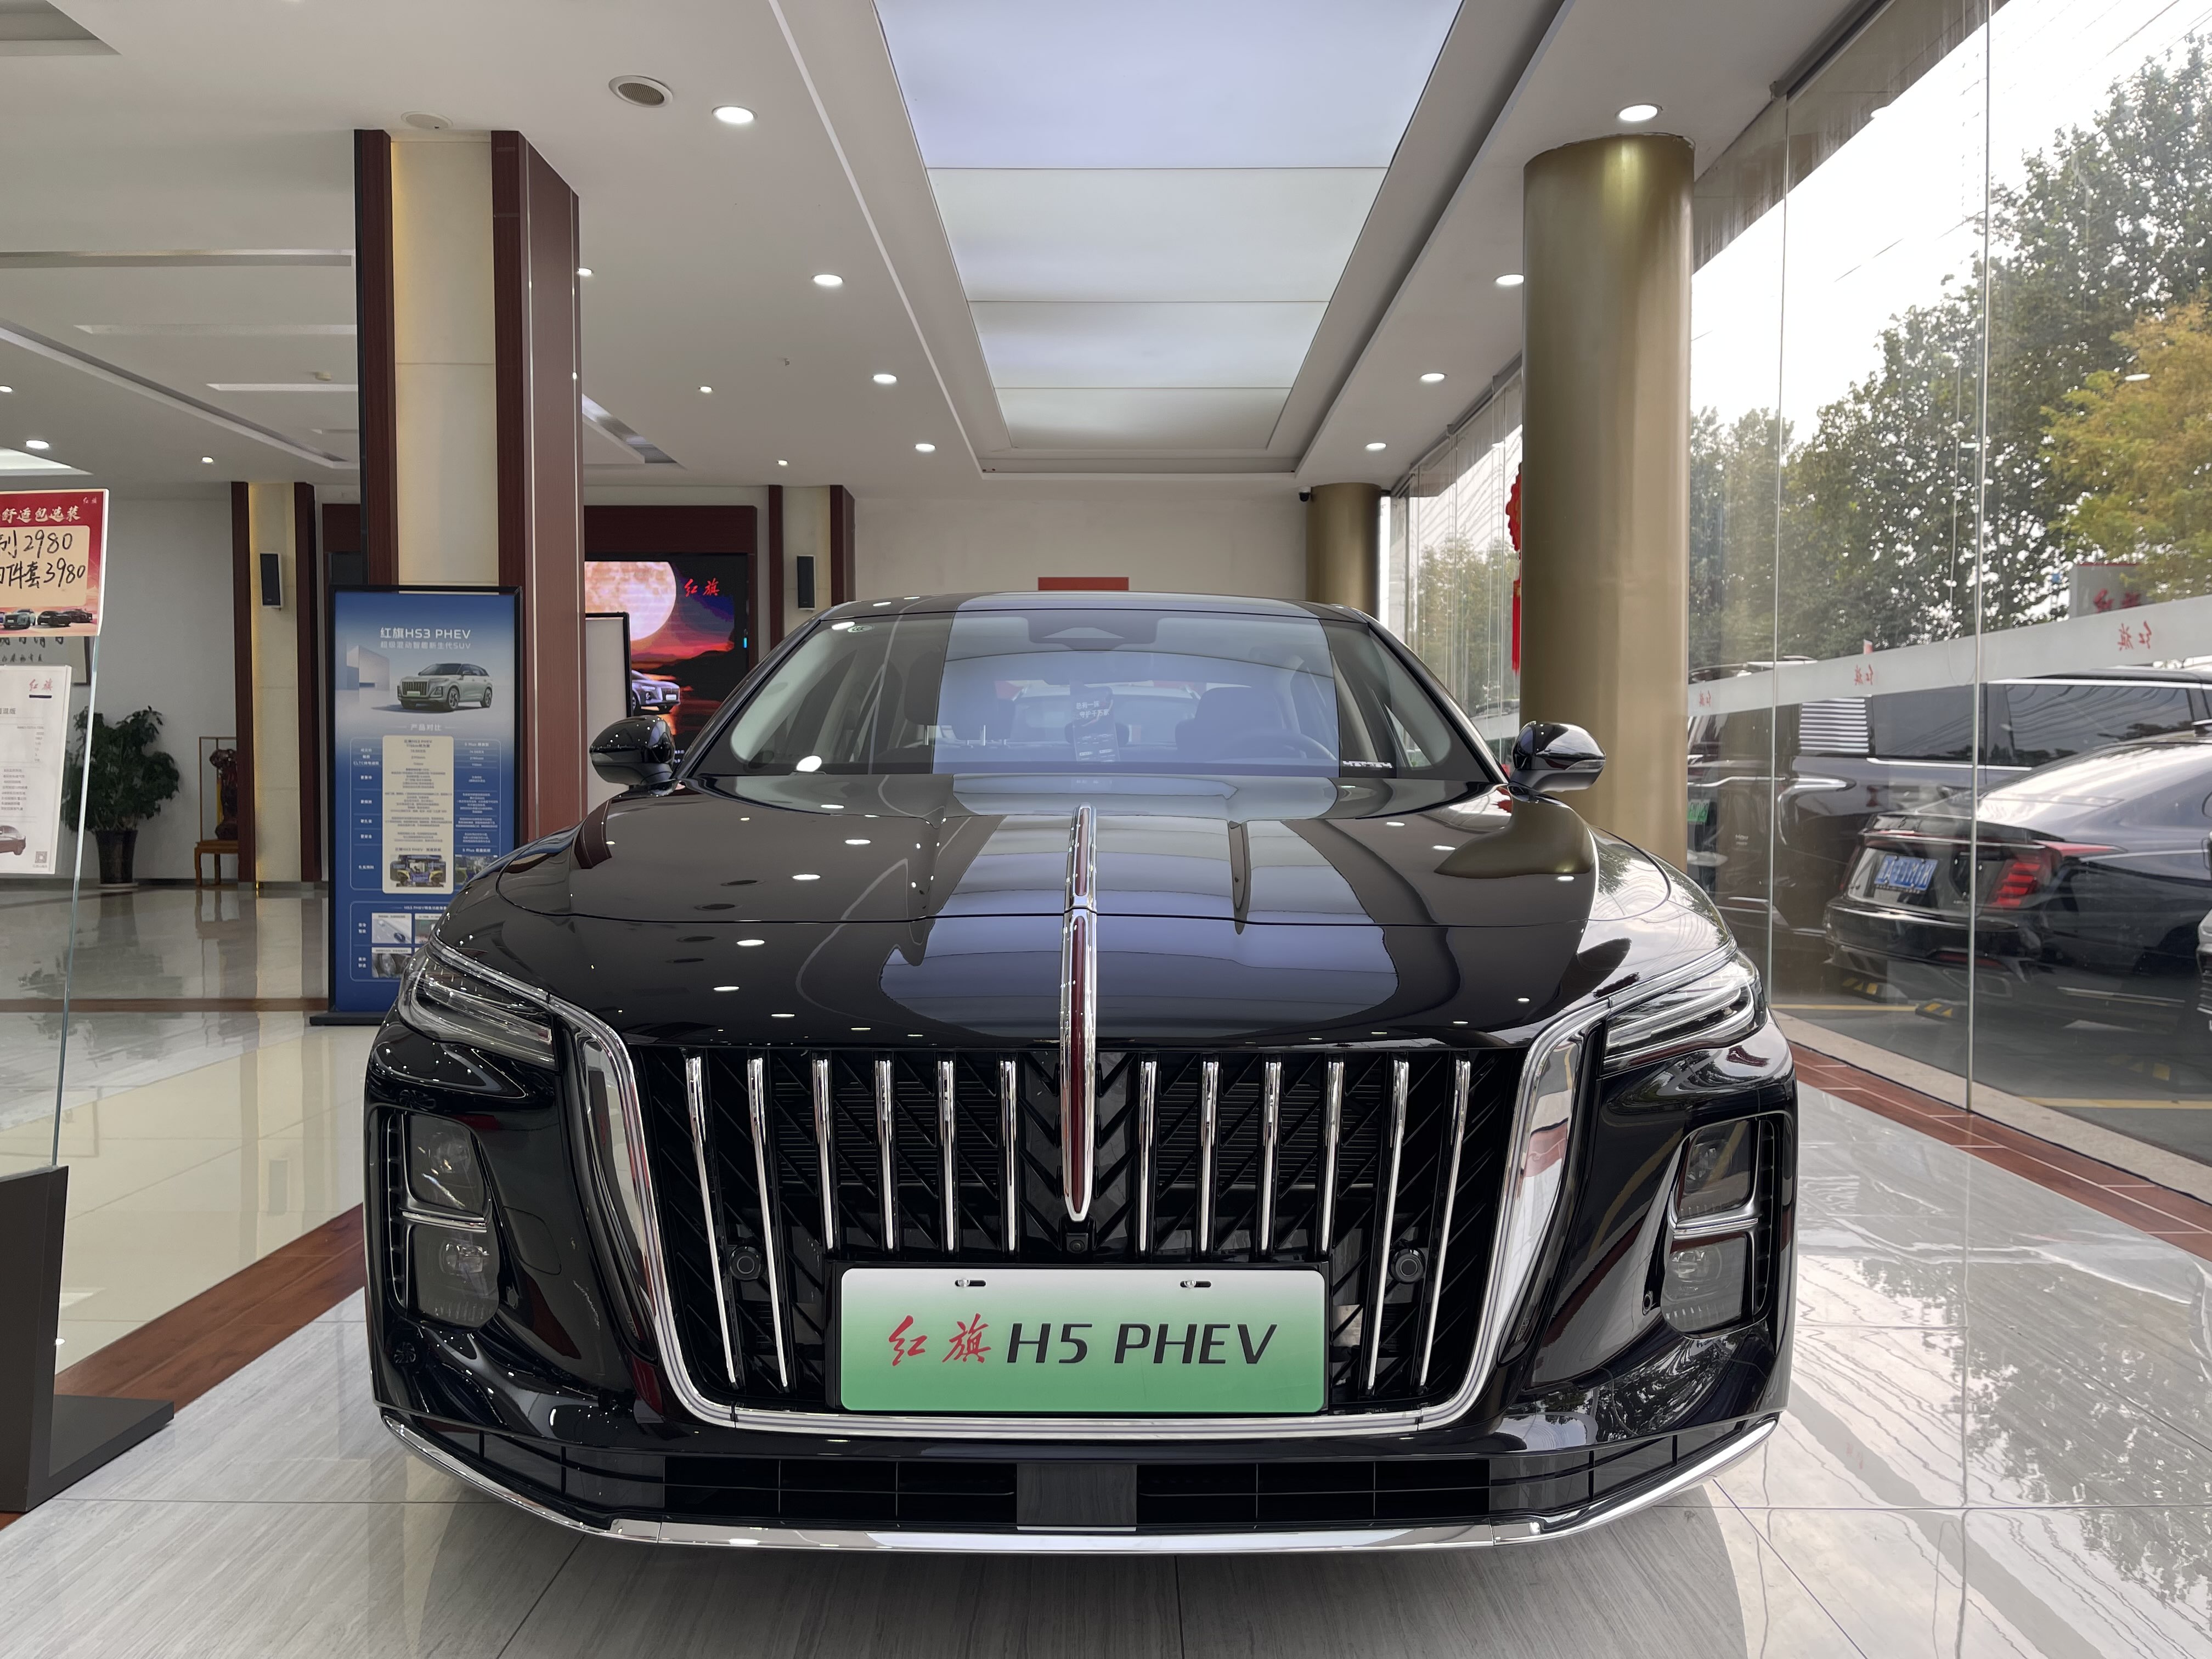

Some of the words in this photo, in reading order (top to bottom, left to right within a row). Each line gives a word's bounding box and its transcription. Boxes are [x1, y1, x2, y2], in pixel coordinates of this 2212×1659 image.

[83, 496, 98, 504] 红旗
[684, 578, 719, 597] 红旗
[380, 627, 431, 639] 红旗HS3
[435, 629, 471, 640] PHEV
[29, 678, 53, 692] 红旗
[889, 1313, 991, 1366] 红旗
[1007, 1323, 1093, 1364] H5
[1114, 1323, 1278, 1365] PHEV
